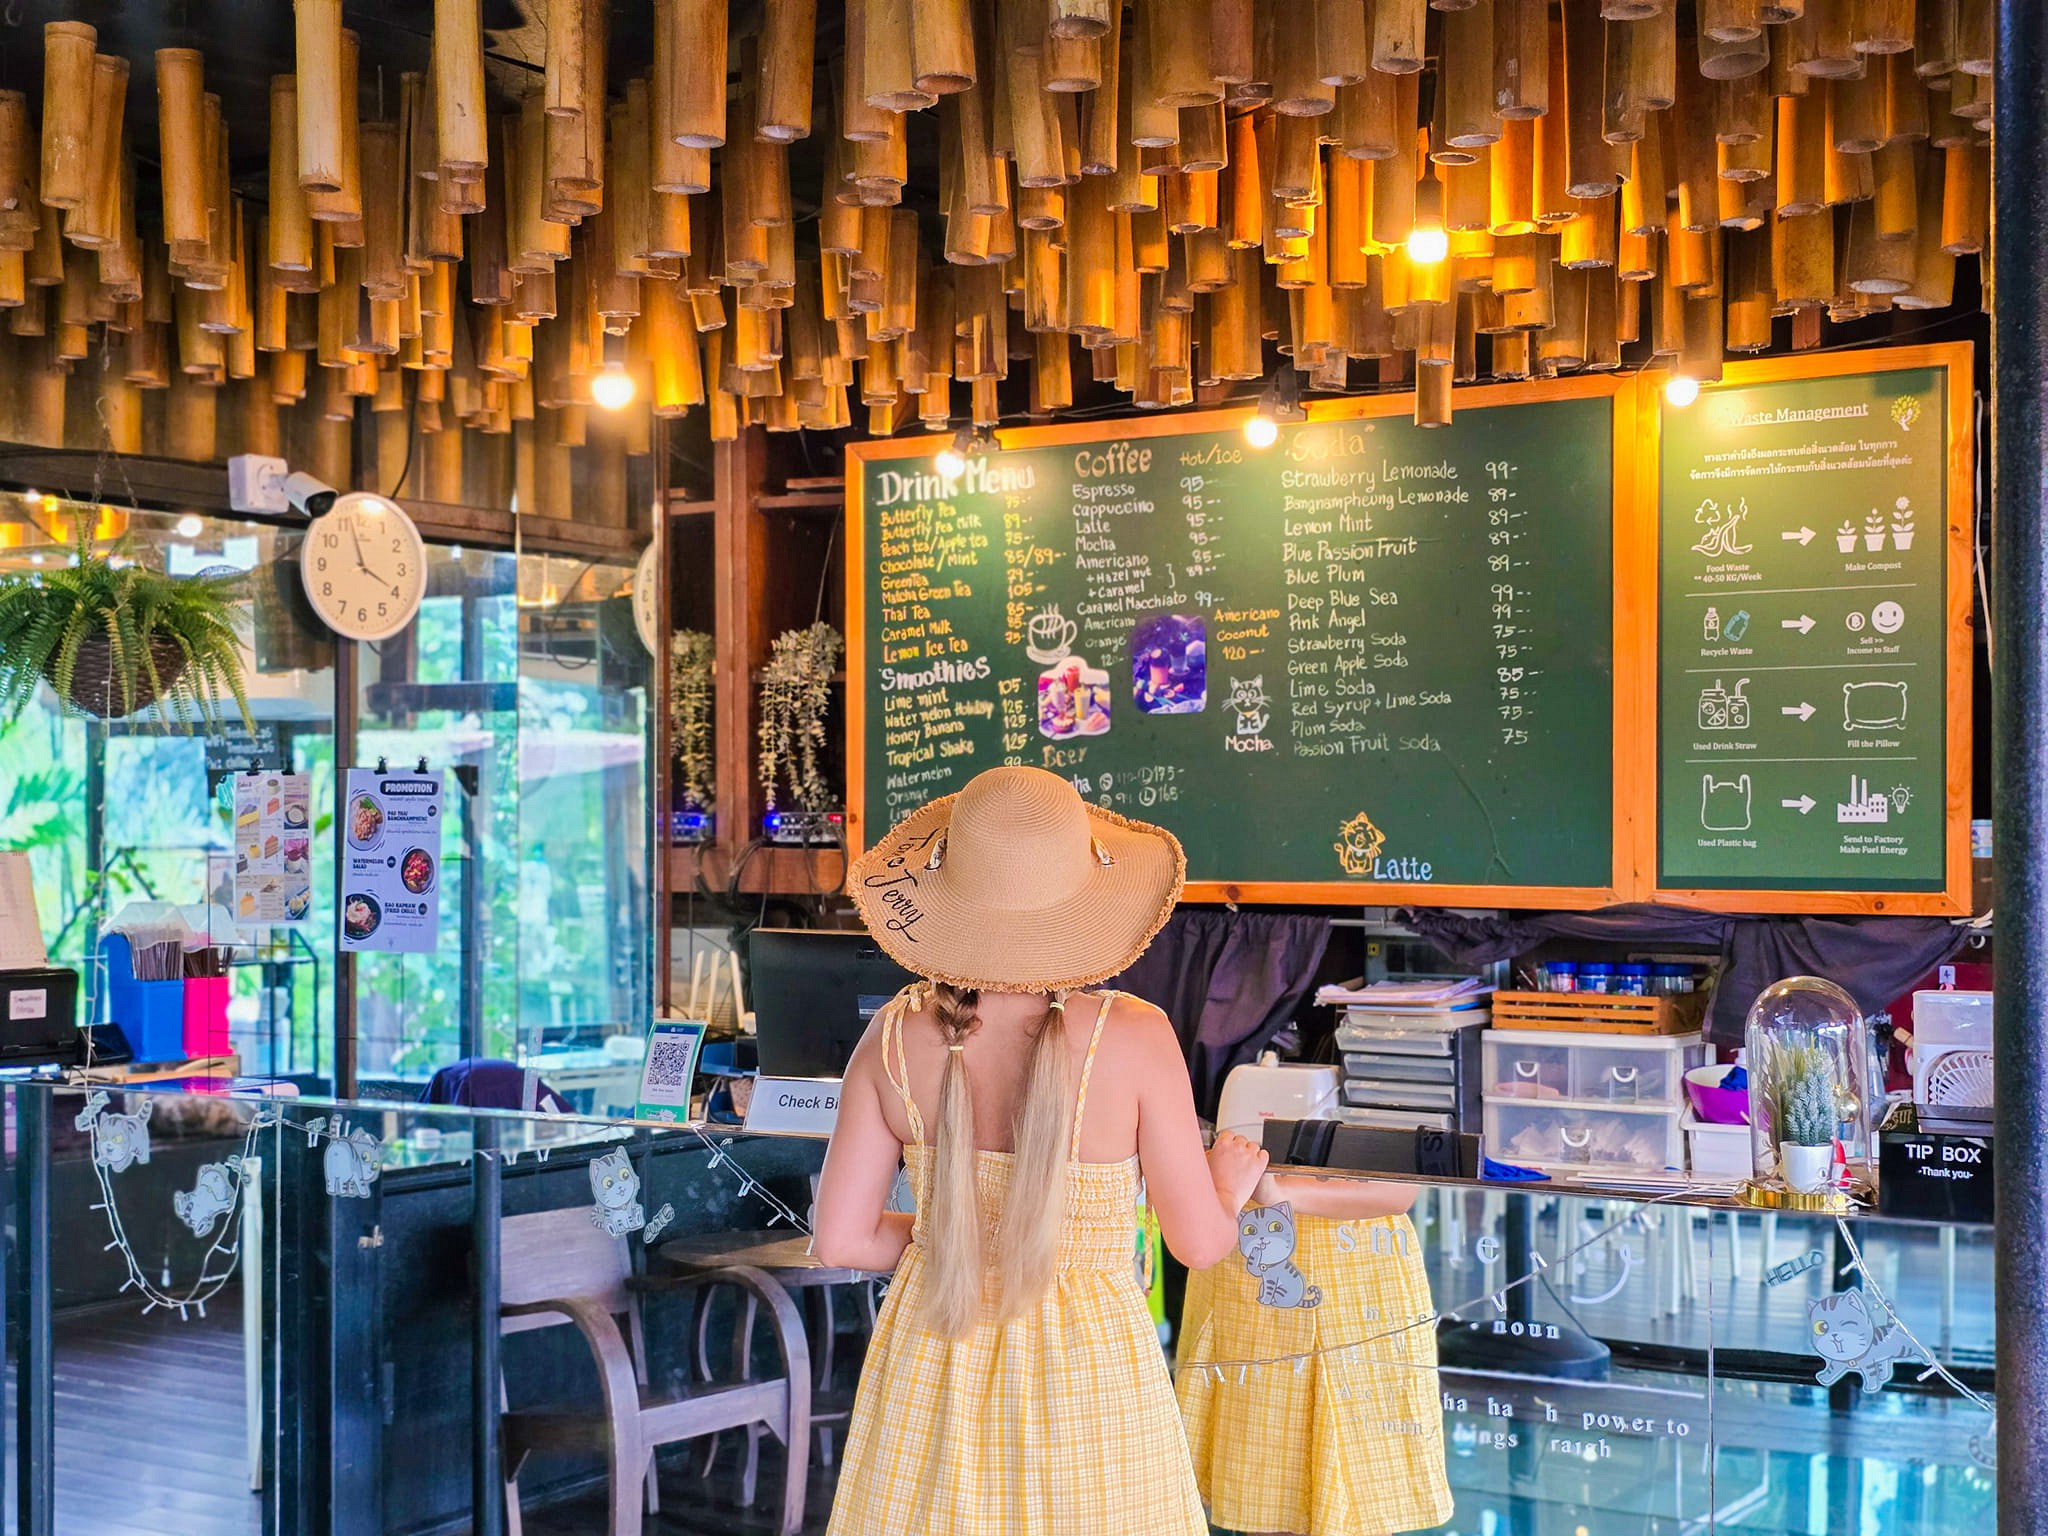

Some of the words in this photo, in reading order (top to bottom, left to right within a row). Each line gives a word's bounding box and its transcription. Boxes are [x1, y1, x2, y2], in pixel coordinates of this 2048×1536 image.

[1775, 402, 1870, 423] Management
[1074, 441, 1153, 478] Coffee
[965, 456, 1036, 495] Menu
[1281, 466, 1376, 493] Strawberry
[1382, 459, 1459, 483] Lemonade
[1072, 483, 1136, 503] Espresso
[1398, 486, 1470, 506] Lemonade
[880, 503, 934, 527] Butterfly
[337, 517, 349, 532] 11
[380, 521, 386, 535] 1
[881, 521, 933, 542] Butterfly
[957, 513, 983, 529] Milk
[1075, 519, 1111, 535] Latte
[1284, 518, 1332, 538] Lemon
[1338, 513, 1374, 534] Mint
[322, 534, 338, 548] 10
[392, 539, 401, 553] 2
[880, 540, 910, 558] Peach
[968, 532, 988, 547] tea
[1075, 535, 1117, 553] Mocha
[1283, 543, 1314, 564] Blue
[1317, 540, 1374, 563] Passion
[1376, 536, 1418, 558] Fruit
[317, 557, 327, 571] 9
[397, 563, 406, 577] 3
[1075, 552, 1149, 570] Americano
[1706, 565, 1726, 573] Food
[1727, 563, 1751, 572] Waste
[1845, 562, 1866, 572] Make
[1867, 561, 1902, 573] Compost
[1132, 566, 1153, 577] nut
[1285, 568, 1321, 586] Blue
[1326, 564, 1366, 583] Plum
[1702, 574, 1725, 583] 40-50
[1726, 573, 1762, 583] KG/Week
[323, 582, 332, 596] 8
[391, 585, 400, 599] 4
[881, 588, 917, 606] Matcha
[918, 585, 952, 601] Green
[953, 580, 973, 597] Tea
[338, 600, 347, 615] 7
[1125, 592, 1188, 610] Macchiato
[1288, 592, 1325, 614] Deep
[1330, 589, 1361, 607] Blue
[1369, 587, 1399, 606] Sea
[358, 608, 367, 622] 6
[377, 603, 387, 617] 5
[882, 607, 907, 623] Thai
[912, 604, 931, 619] Tea
[1213, 607, 1281, 623] Americano
[1084, 617, 1136, 631] Americano
[1289, 612, 1320, 633] Pink
[1328, 608, 1367, 634] Angel
[881, 623, 925, 643] Caramel
[928, 618, 953, 635] Milk
[1216, 624, 1270, 642] Coconut
[883, 643, 920, 664] Lemon
[925, 640, 946, 658] Ice
[948, 636, 969, 653] Tea
[1288, 633, 1366, 655] Strawberry
[1370, 632, 1407, 648] Soda
[1847, 647, 1873, 655] Income
[1874, 646, 1882, 654] to
[1883, 645, 1900, 654] Staff
[1860, 637, 1873, 645] Sell
[1701, 647, 1728, 657] Recycle
[1730, 646, 1753, 656] Waste
[1287, 659, 1328, 677] Green
[1334, 655, 1368, 678] Apple
[1373, 650, 1409, 669] Soda
[880, 656, 991, 691] Smoothies
[1290, 679, 1329, 698] Lime
[1335, 677, 1376, 697] Soda
[884, 695, 913, 712] Lime
[916, 686, 950, 707] mint
[1292, 700, 1318, 717] Red
[1324, 697, 1372, 719] Syrup
[1386, 692, 1417, 710] Lime
[1419, 690, 1452, 706] Soda
[886, 728, 921, 748] Honey
[924, 719, 965, 740] Banana
[1290, 720, 1326, 739] Plum
[1329, 719, 1366, 733] Soda
[1225, 735, 1275, 753] Mocha
[1293, 741, 1345, 758] Passion
[1348, 732, 1391, 753] Fruit
[1399, 733, 1442, 752] Soda
[1693, 742, 1711, 750] Used
[1713, 742, 1734, 750] Drink
[1735, 742, 1757, 750] Straw
[1847, 739, 1860, 748] Fill
[1861, 739, 1873, 748] the
[1874, 739, 1900, 748] Pillow
[886, 742, 935, 768] Tropical
[939, 738, 975, 758] Shake
[1041, 744, 1087, 768] Beer
[385, 783, 433, 793] PROMOTION
[886, 788, 929, 806] Orange
[889, 808, 912, 822] Lim
[1698, 838, 1716, 847] Used
[1717, 838, 1743, 847] Plastic
[1744, 838, 1757, 848] bag
[1843, 835, 1863, 843] Send
[1873, 835, 1904, 845] Factory
[1840, 845, 1861, 854] Make
[1862, 845, 1878, 854] Fuel
[1880, 845, 1908, 856] Energy
[1373, 856, 1433, 881] Latte
[864, 868, 924, 943] Jerry
[778, 1094, 821, 1109] Check
[825, 1097, 838, 1110] Bi
[1905, 1144, 1934, 1160] TIP
[1942, 1146, 1982, 1163] BOX
[1765, 1251, 1825, 1287] HELLO
[1492, 1319, 1561, 1339] noun
[1583, 1411, 1655, 1432] power
[1667, 1419, 1690, 1436] to
